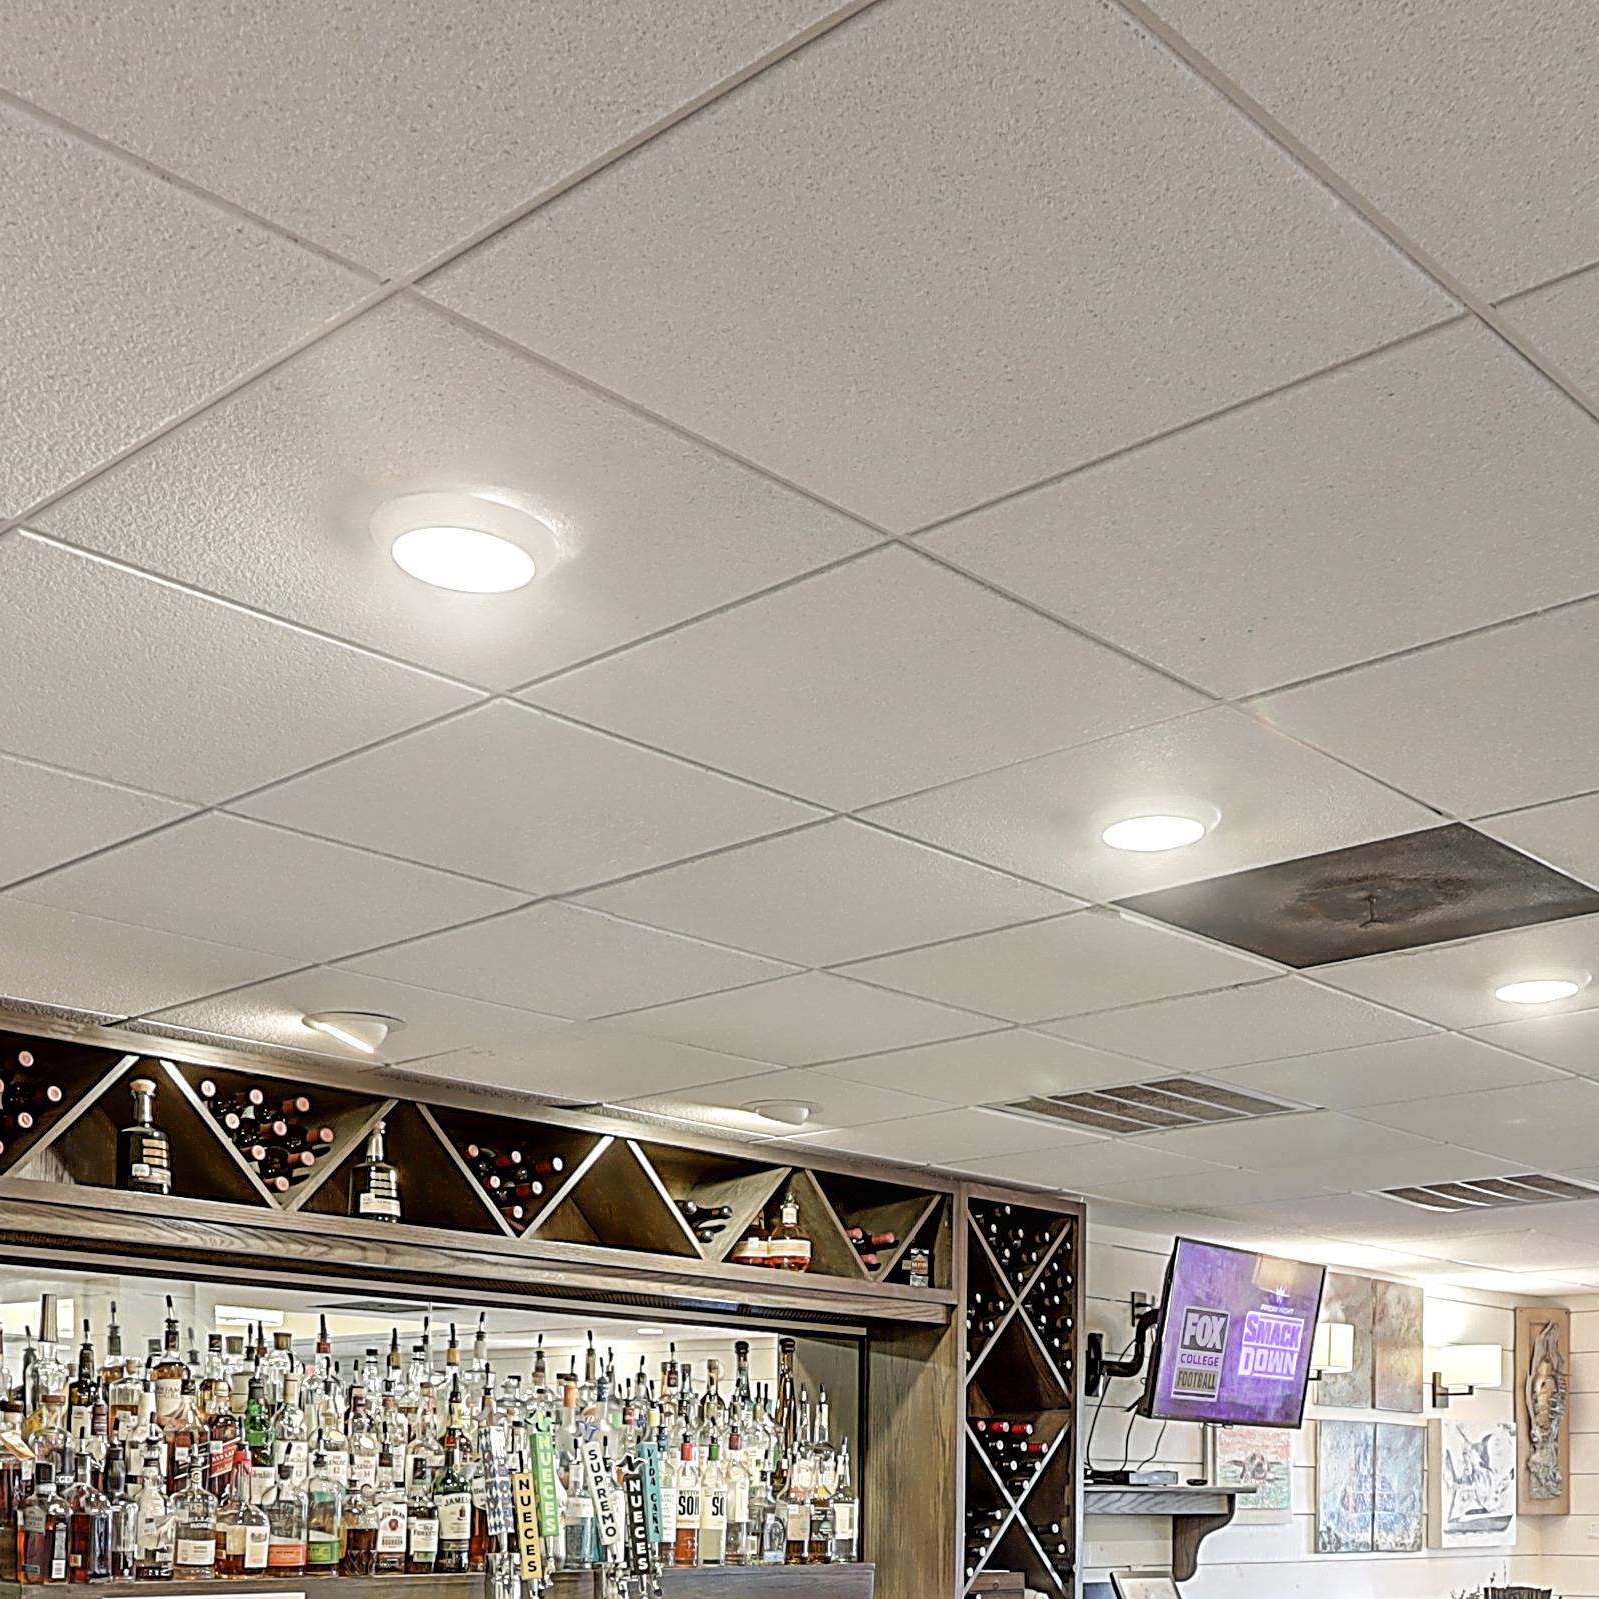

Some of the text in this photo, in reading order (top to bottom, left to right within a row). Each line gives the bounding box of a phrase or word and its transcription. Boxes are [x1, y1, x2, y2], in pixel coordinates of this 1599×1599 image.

[1184, 1312, 1227, 1350] FOX
[1244, 1314, 1302, 1349] SMACK
[1181, 1353, 1220, 1367] COLLEGE
[1239, 1349, 1298, 1376] DOWN
[1176, 1370, 1217, 1390] FOOTBALL
[538, 1434, 556, 1533] NUECES
[647, 1449, 656, 1486] VIDA
[588, 1449, 617, 1537] SUPREMO
[519, 1479, 537, 1572] NUECES
[629, 1479, 649, 1571] NUECES
